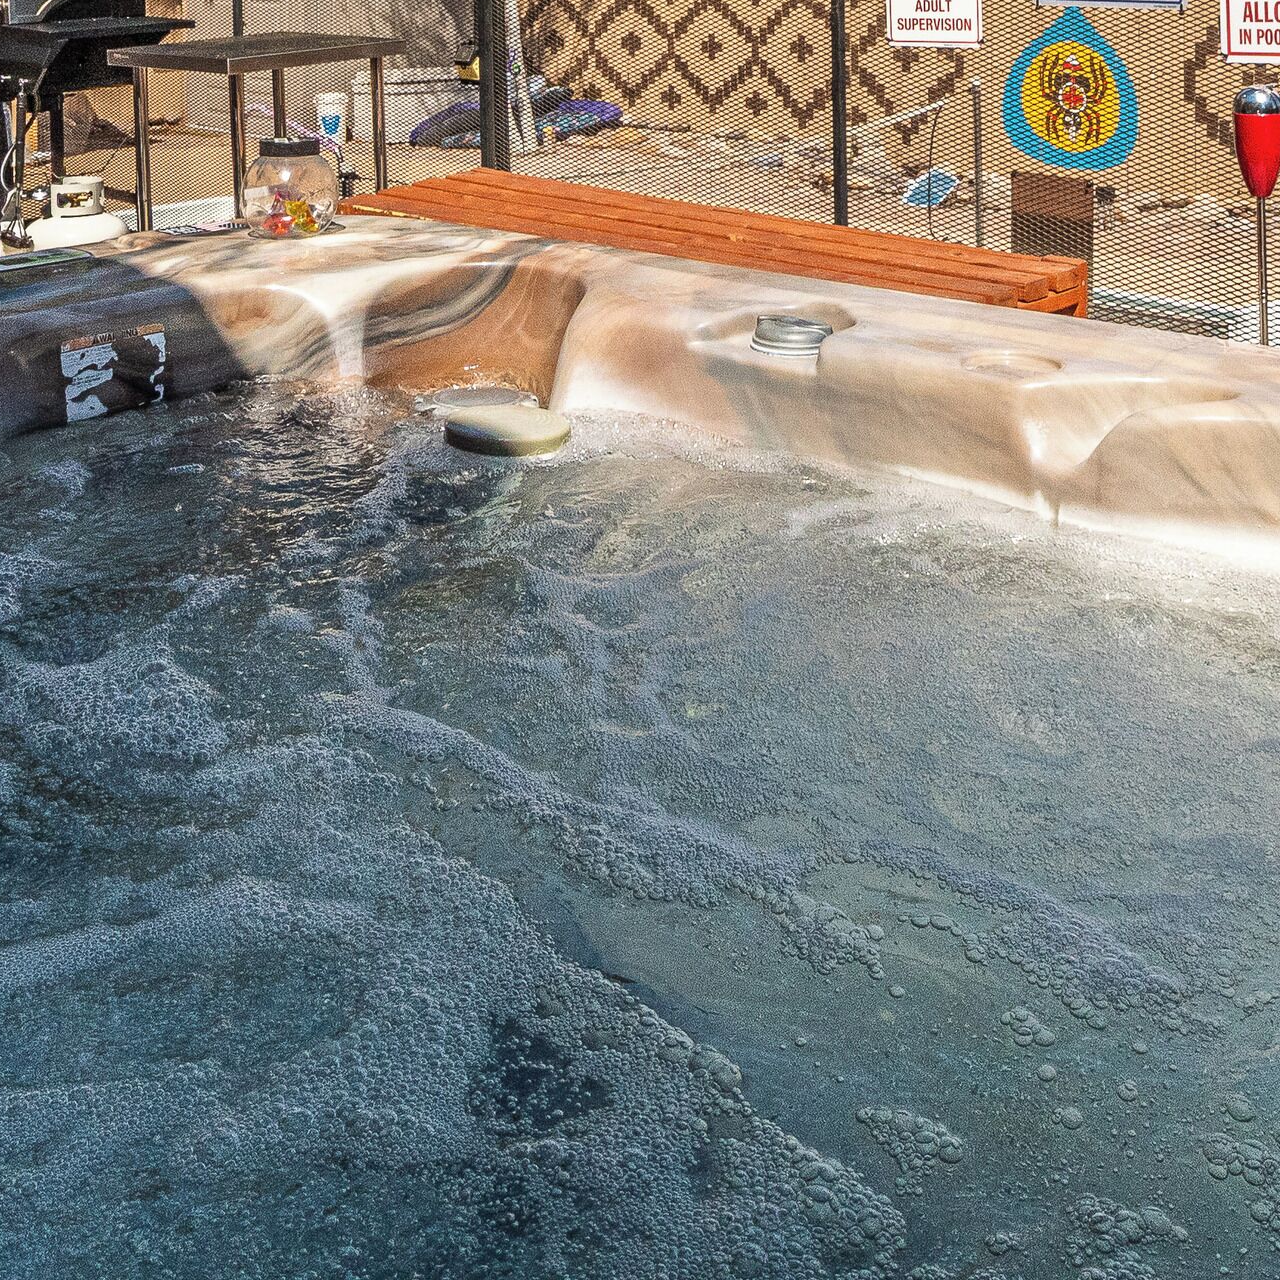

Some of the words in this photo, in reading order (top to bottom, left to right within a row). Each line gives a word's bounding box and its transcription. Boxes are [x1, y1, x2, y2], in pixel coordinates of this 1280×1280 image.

[915, 0, 952, 12] ADULT
[897, 18, 972, 31] SUPERVISION
[1239, 28, 1252, 45] IN
